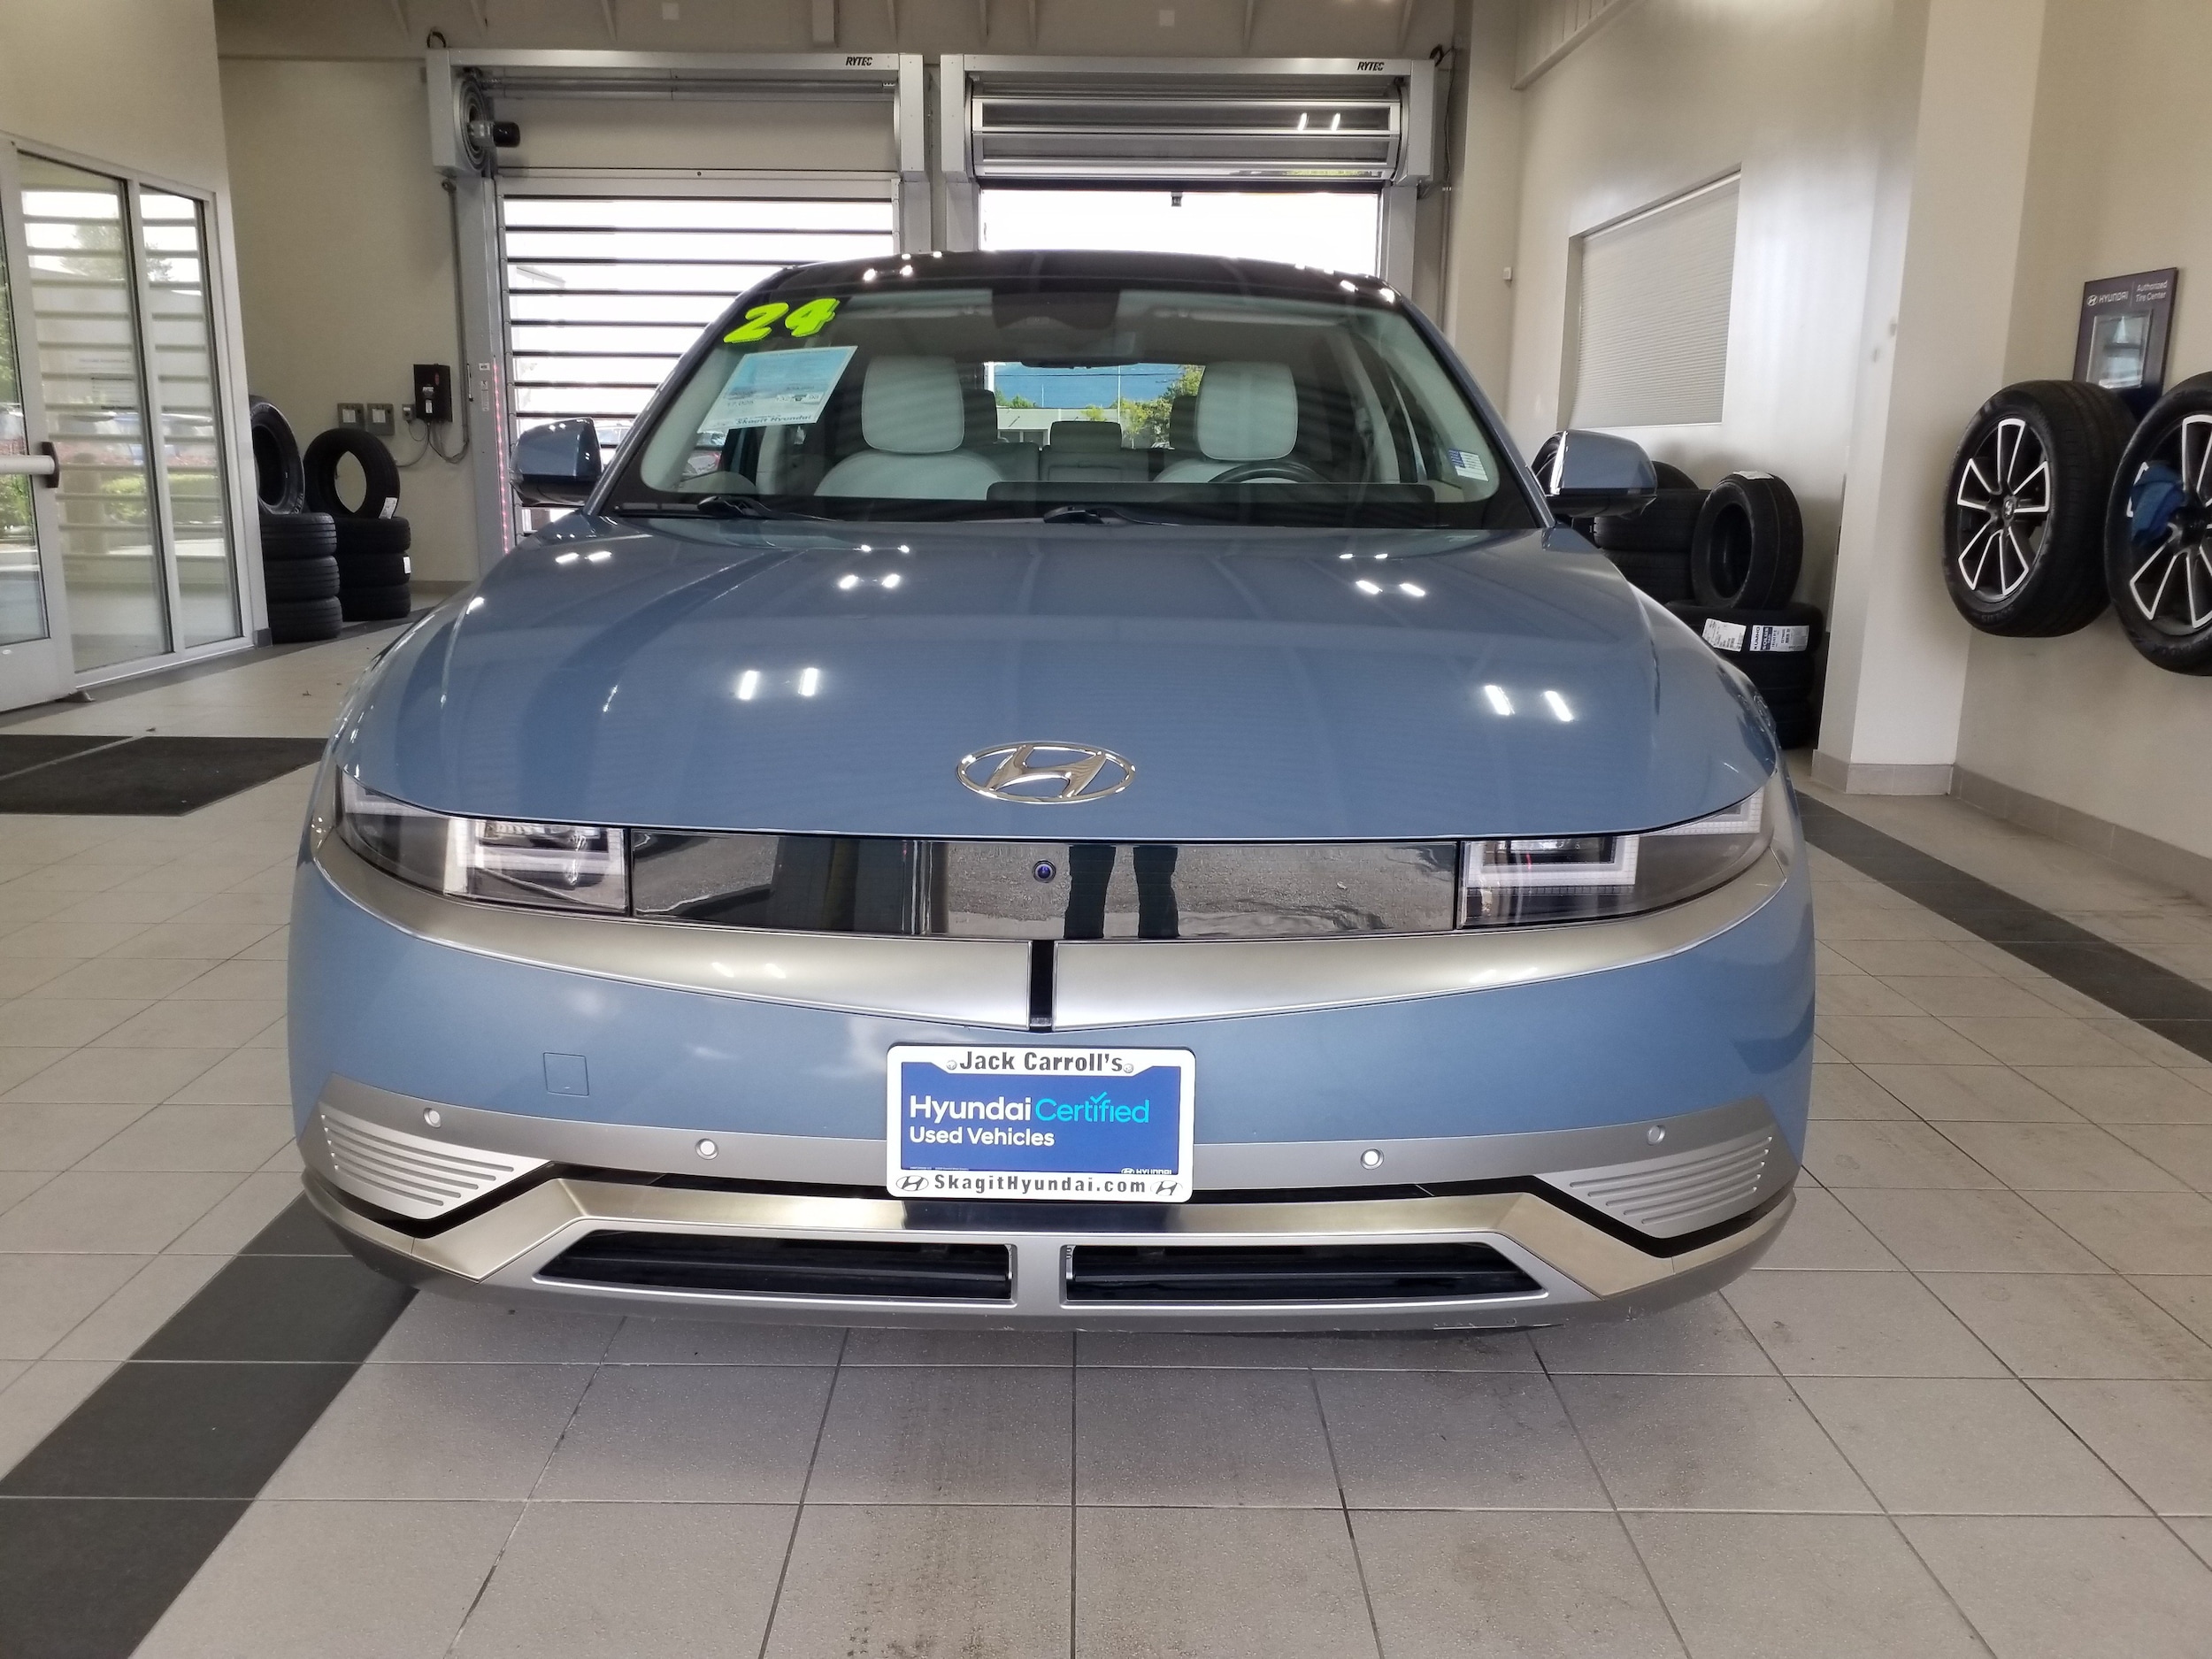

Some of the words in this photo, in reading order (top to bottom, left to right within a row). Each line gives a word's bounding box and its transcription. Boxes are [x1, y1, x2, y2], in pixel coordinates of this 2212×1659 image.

[845, 56, 873, 66] RYTEC
[1356, 61, 1385, 71] RYTEC
[2099, 290, 2129, 303] HYUNDAI
[723, 297, 841, 343] 24
[959, 1051, 1016, 1071] Jack
[1024, 1051, 1124, 1072] Carroll's
[910, 1094, 1032, 1124] Hyundai
[1035, 1092, 1150, 1124] Certified
[910, 1125, 964, 1144] Used
[966, 1127, 1056, 1147] Vehicles
[934, 1173, 1146, 1194] SkagitHyundai.com
